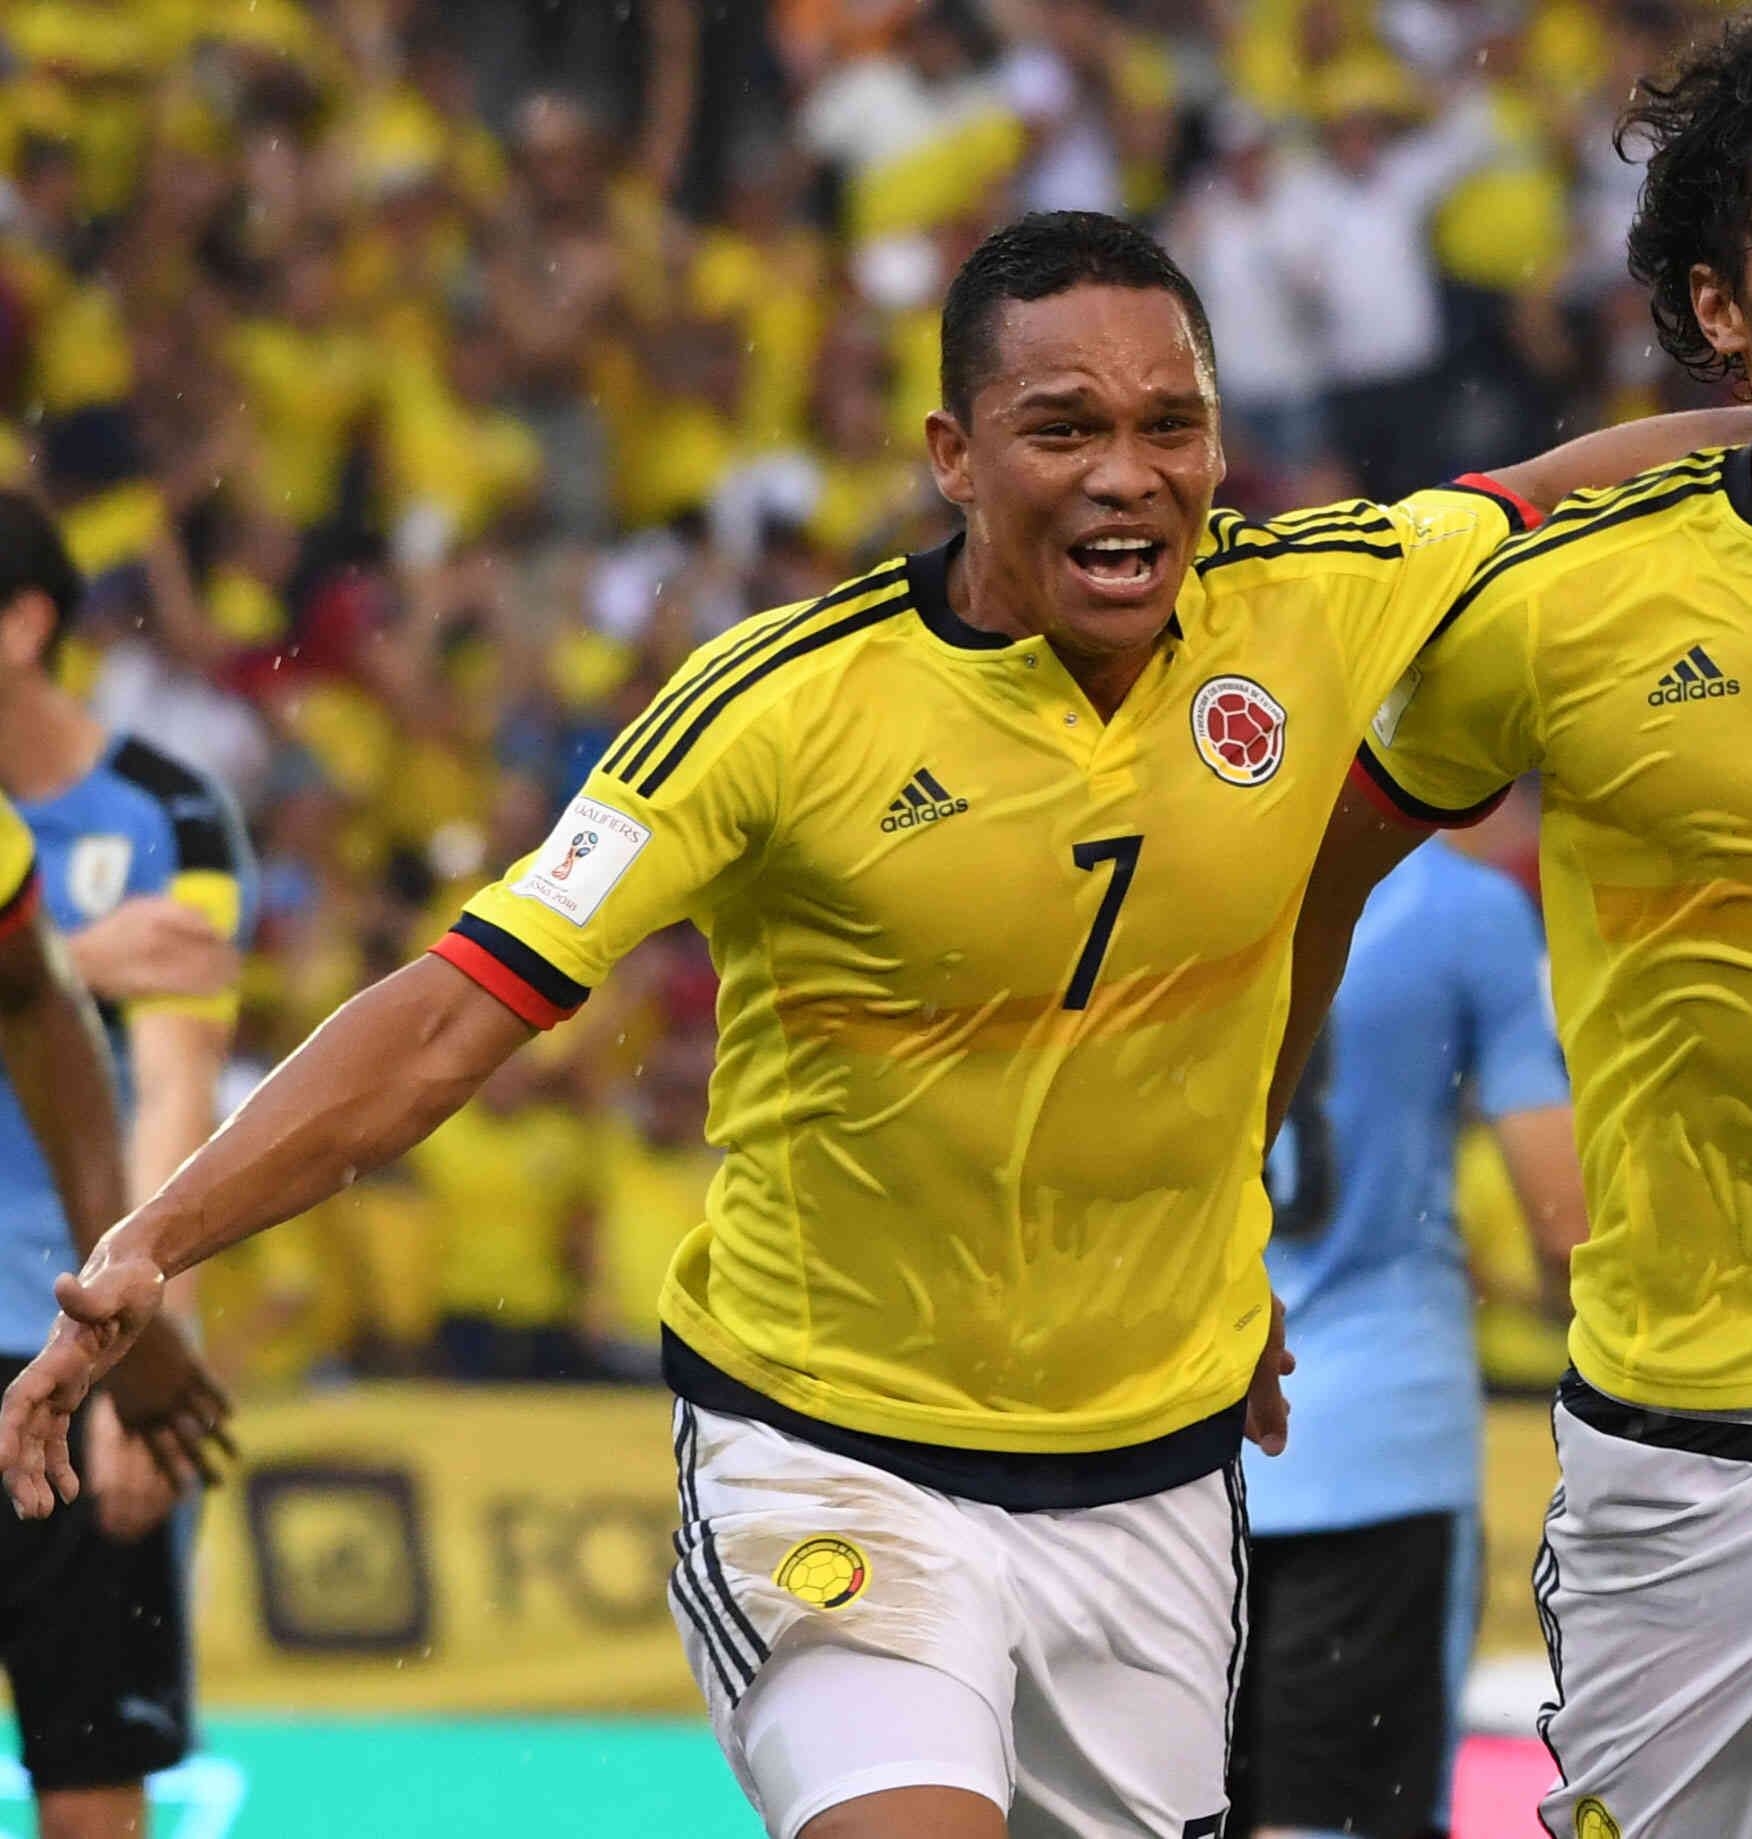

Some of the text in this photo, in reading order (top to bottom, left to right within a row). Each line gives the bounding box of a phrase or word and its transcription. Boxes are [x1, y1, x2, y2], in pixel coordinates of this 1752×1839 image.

[1647, 675, 1740, 707] adidas
[880, 795, 969, 834] adidas
[1061, 834, 1145, 1011] 7
